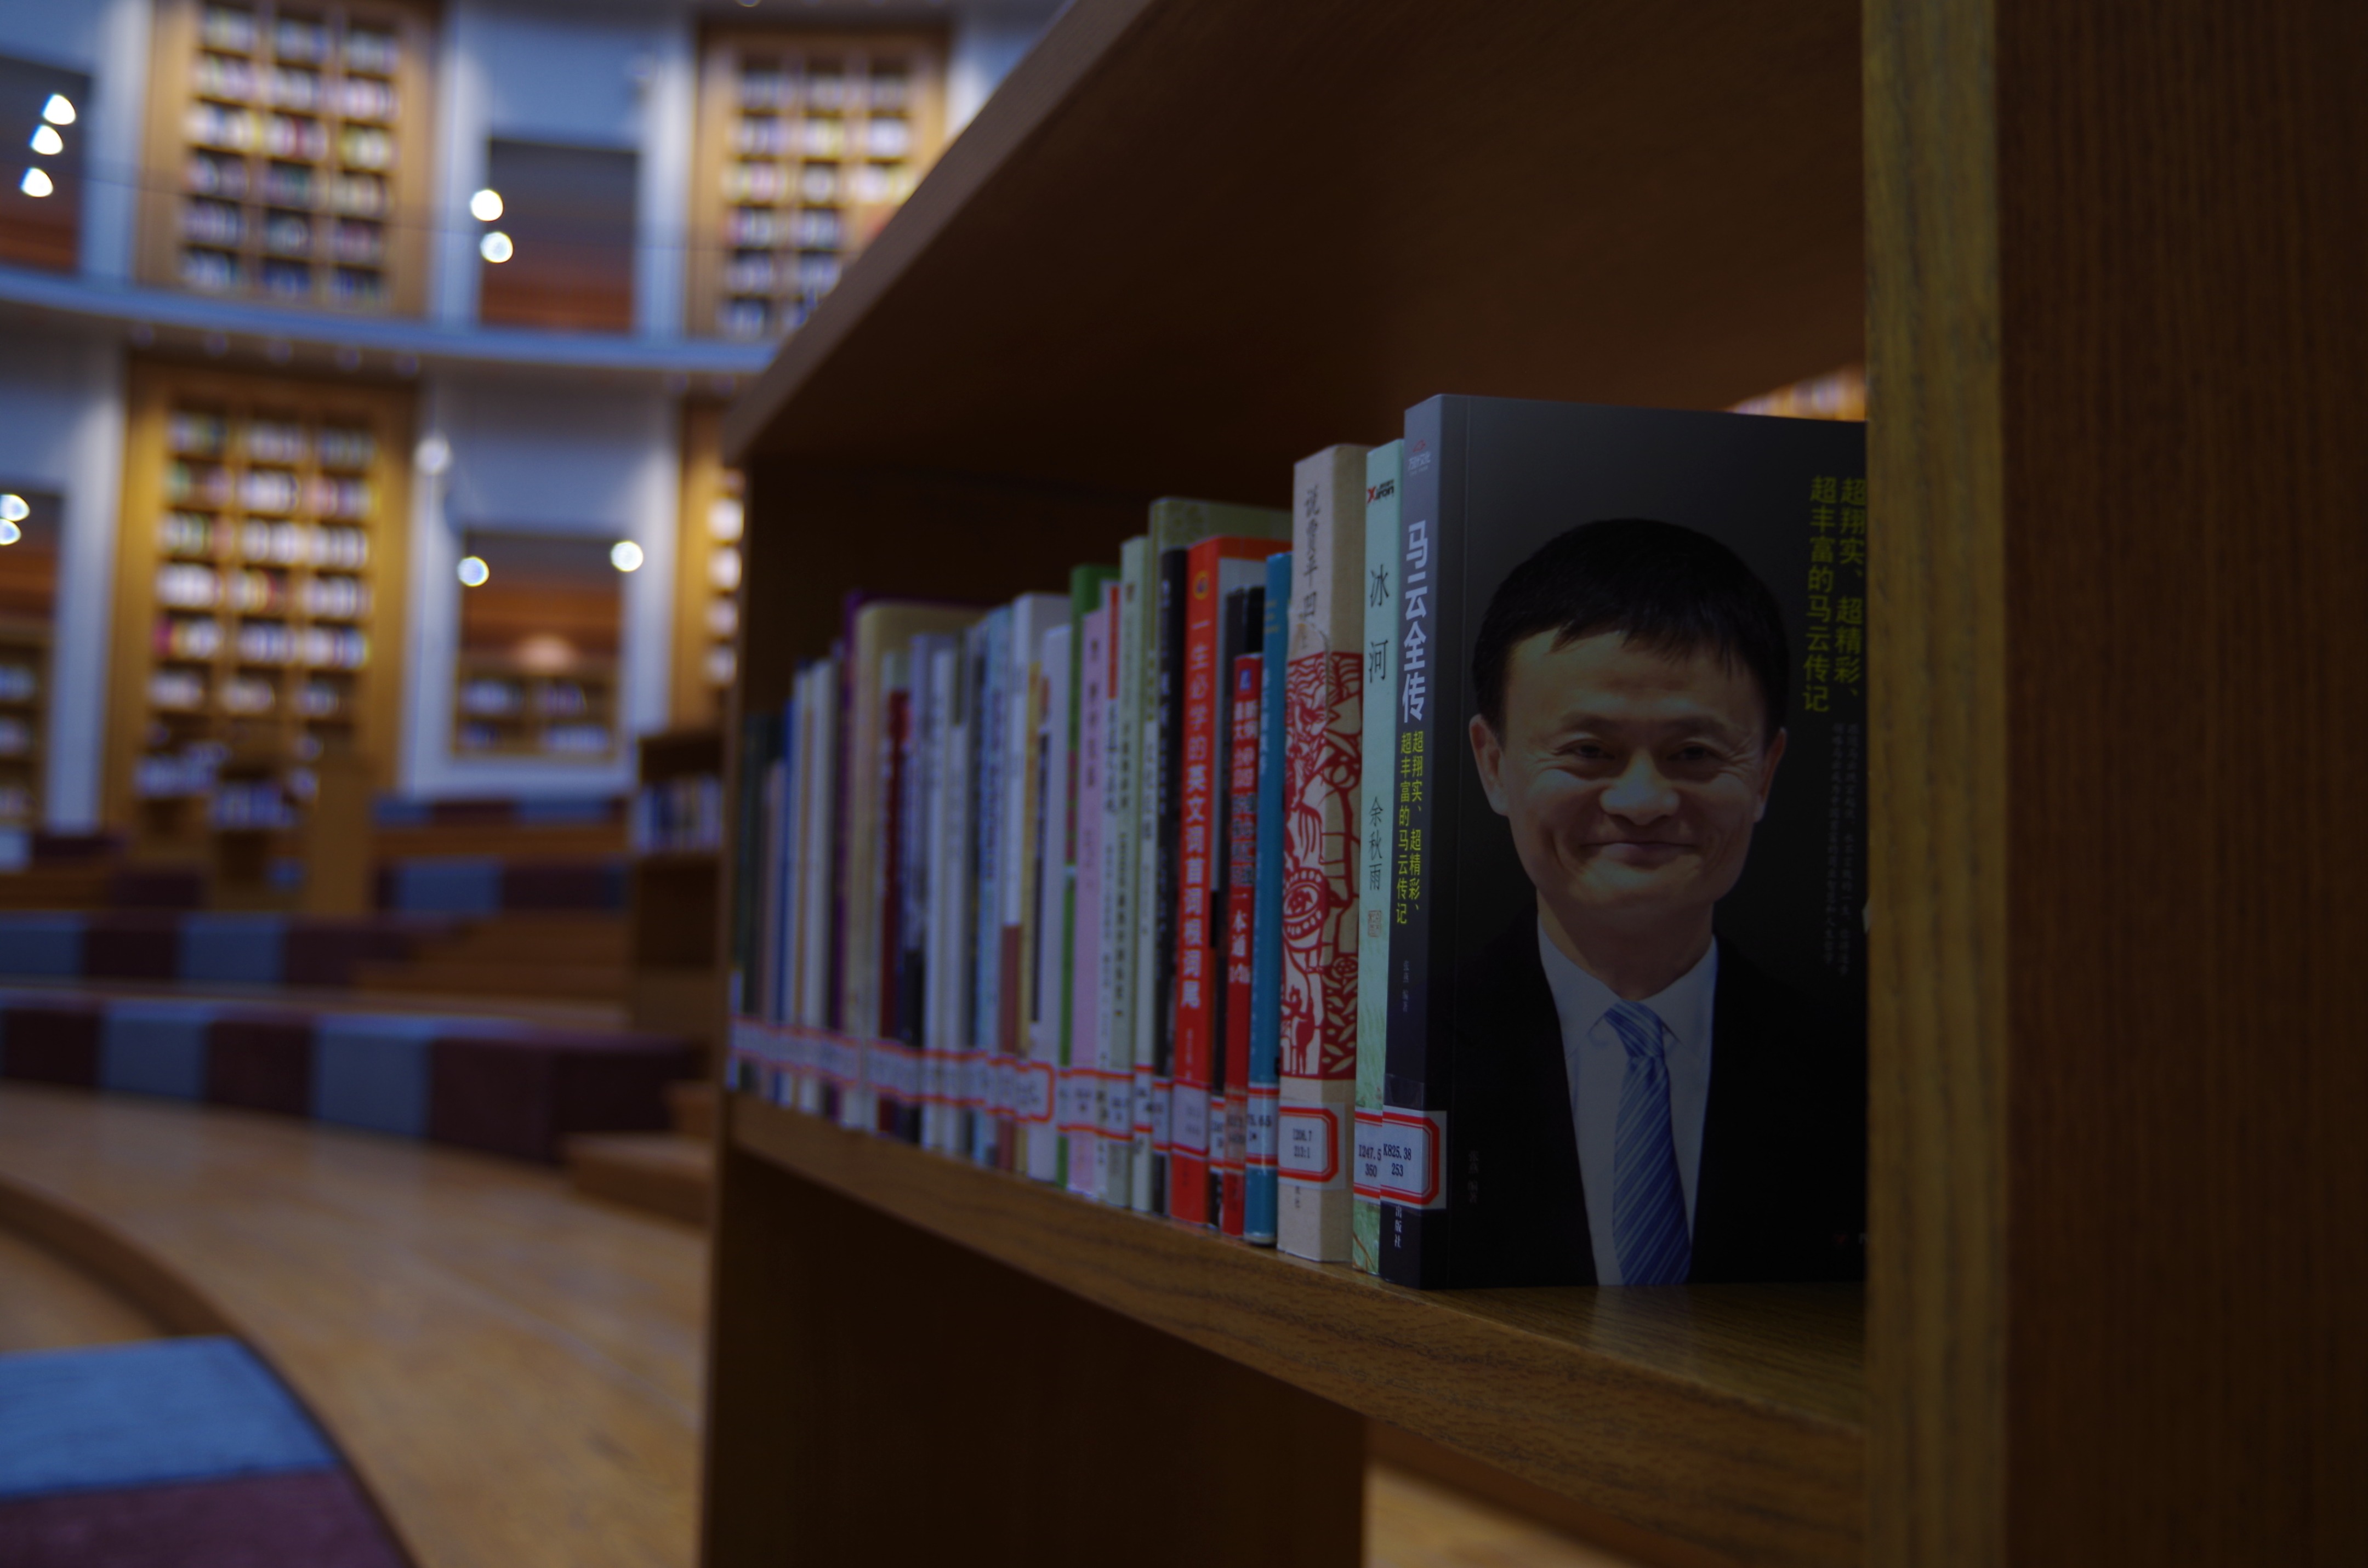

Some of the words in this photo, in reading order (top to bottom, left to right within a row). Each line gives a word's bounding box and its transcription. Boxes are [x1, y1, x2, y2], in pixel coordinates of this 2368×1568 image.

[1369, 565, 1389, 683] 冰河
[1402, 521, 1428, 723] 马云全传
[1803, 475, 1837, 714] 超丰富的马云传记
[1368, 796, 1384, 892] 余秋雨
[1396, 732, 1412, 925] 超丰富的马云传记
[1408, 731, 1424, 911] 超翔实、超精彩、
[1359, 1144, 1381, 1161] I247.5
[1384, 1143, 1411, 1161] K825.38
[1391, 1162, 1403, 1177] 253
[1394, 1205, 1402, 1248] 出版社
